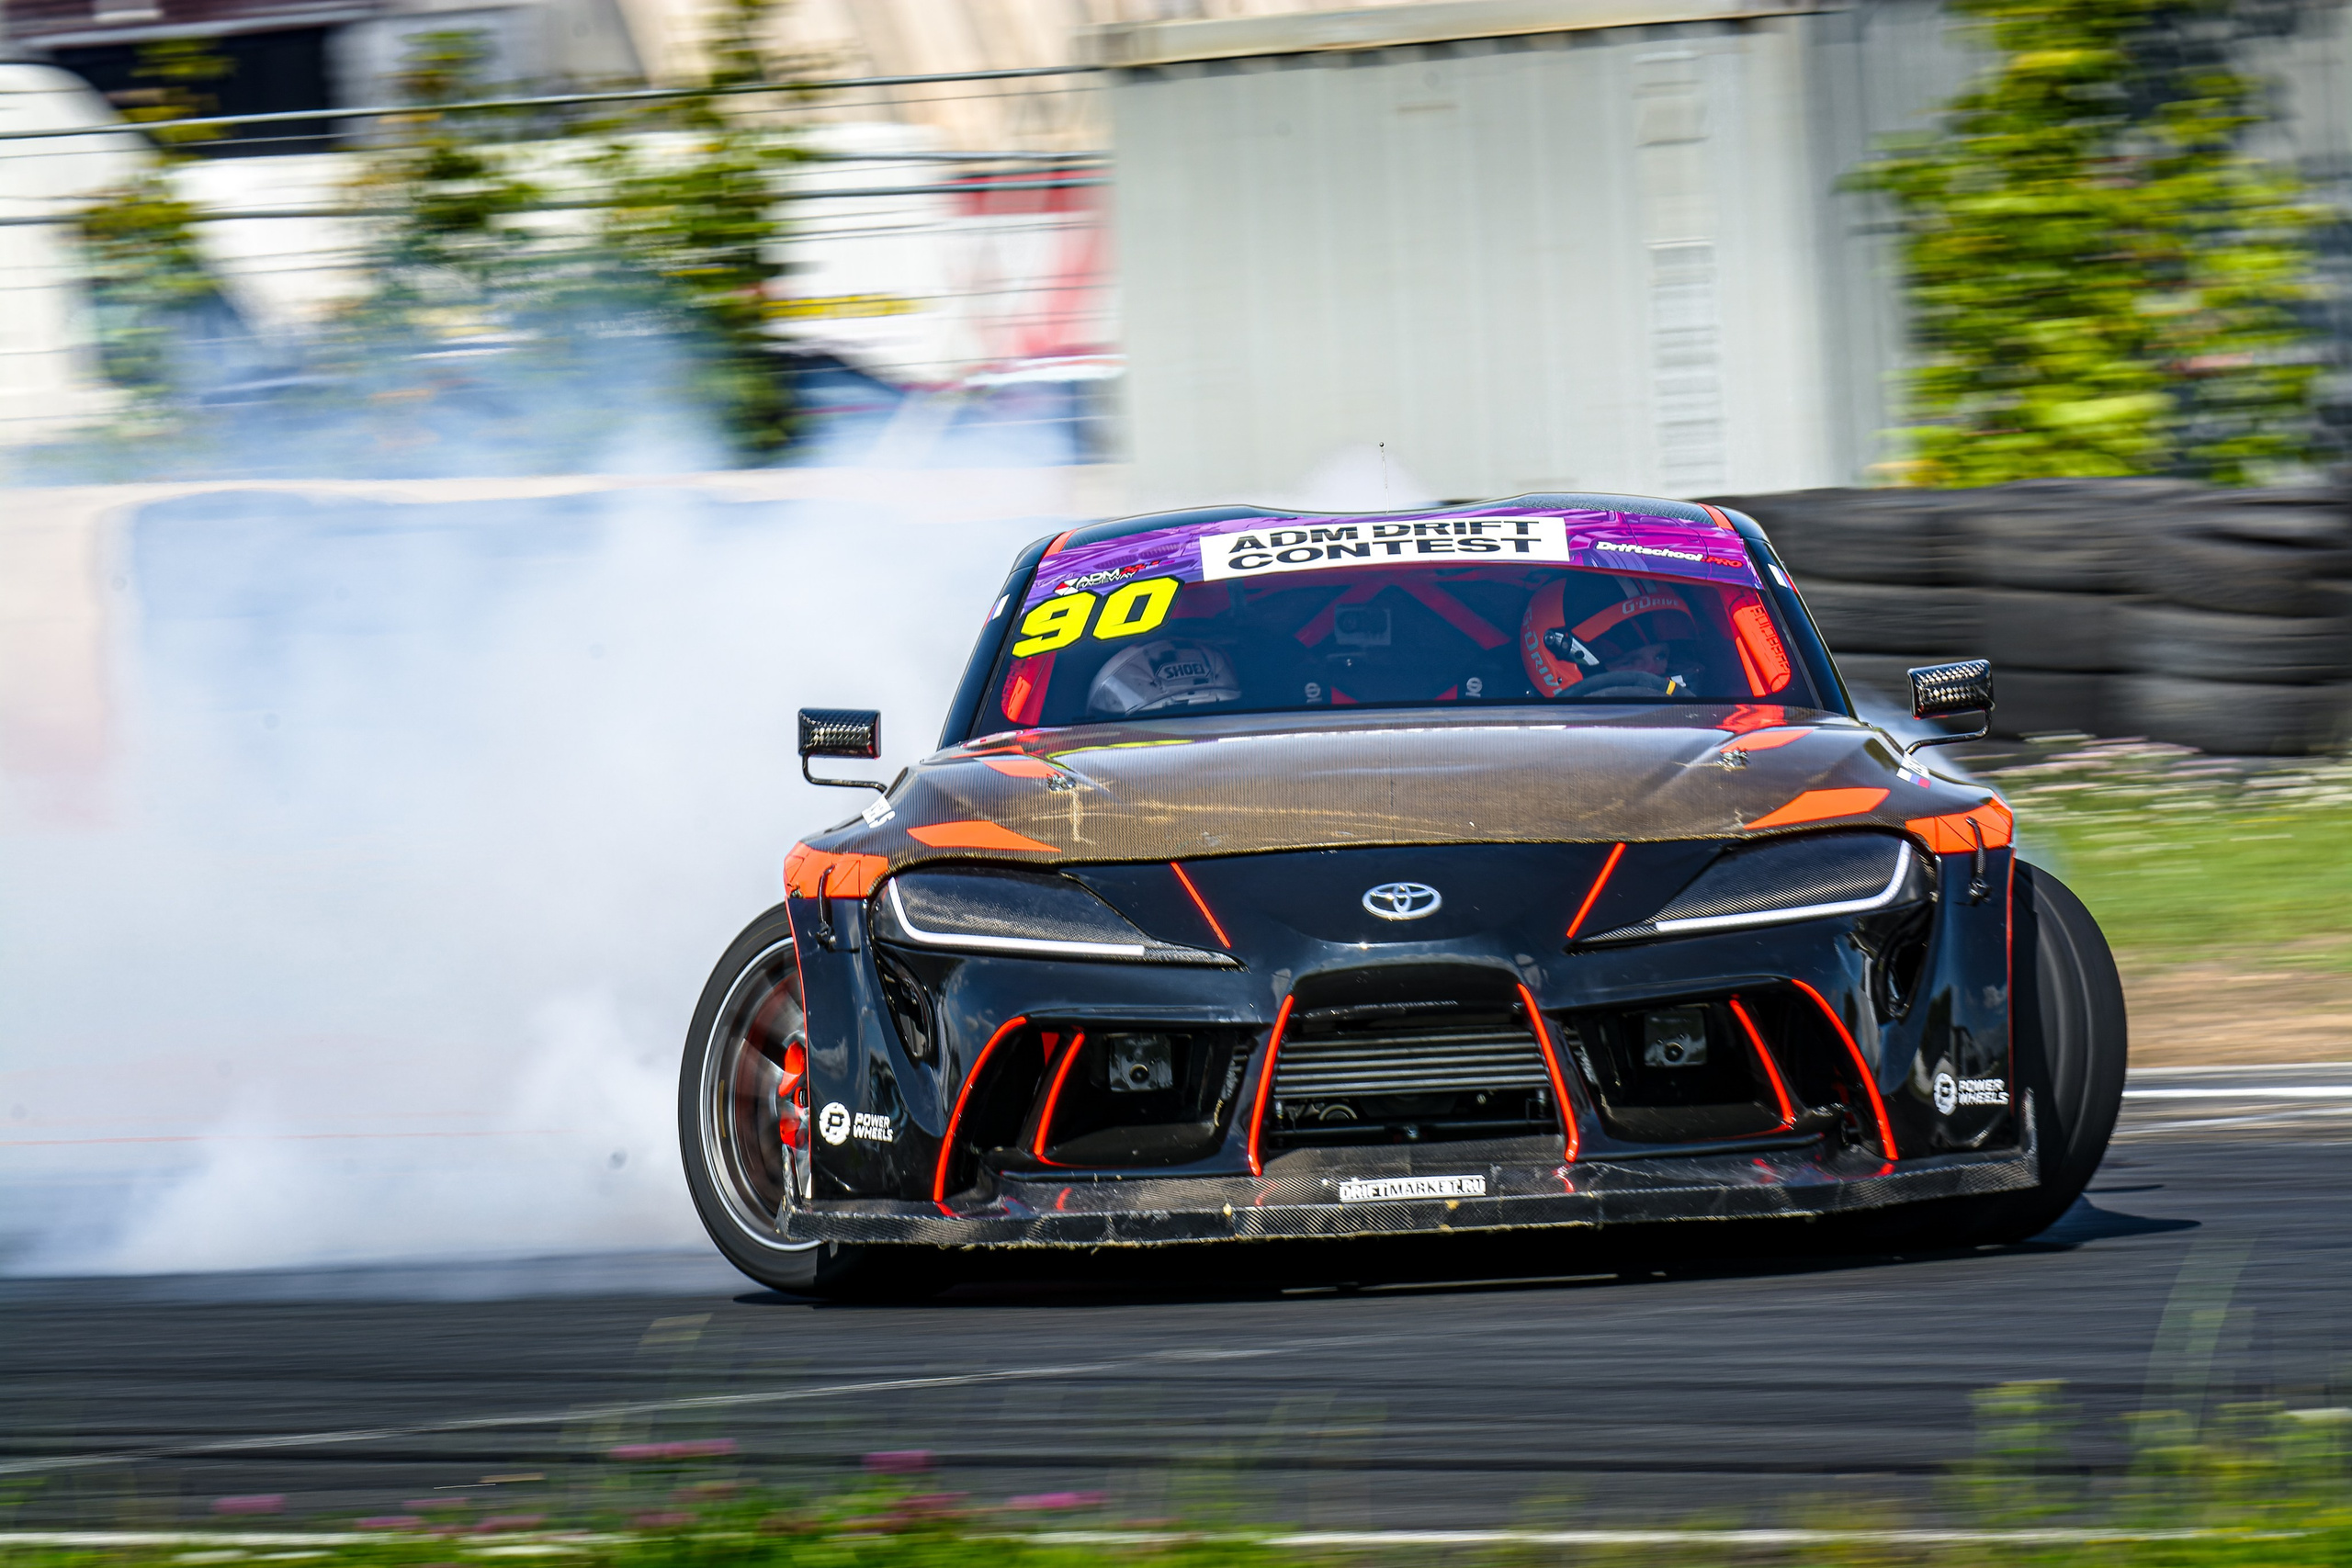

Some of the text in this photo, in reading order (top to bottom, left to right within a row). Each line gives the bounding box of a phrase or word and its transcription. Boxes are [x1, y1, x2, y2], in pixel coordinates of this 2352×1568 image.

[1228, 520, 1541, 554] ADM DRIFT
[1227, 537, 1542, 570] CONTEST
[1076, 568, 1121, 585] ADM
[1012, 576, 1180, 659] 90
[1163, 663, 1206, 680] SHOEI
[1958, 1078, 2006, 1092] POWER
[1958, 1091, 2010, 1105] WHEELS
[854, 1112, 891, 1129] POWER
[853, 1125, 894, 1143] WHEELS
